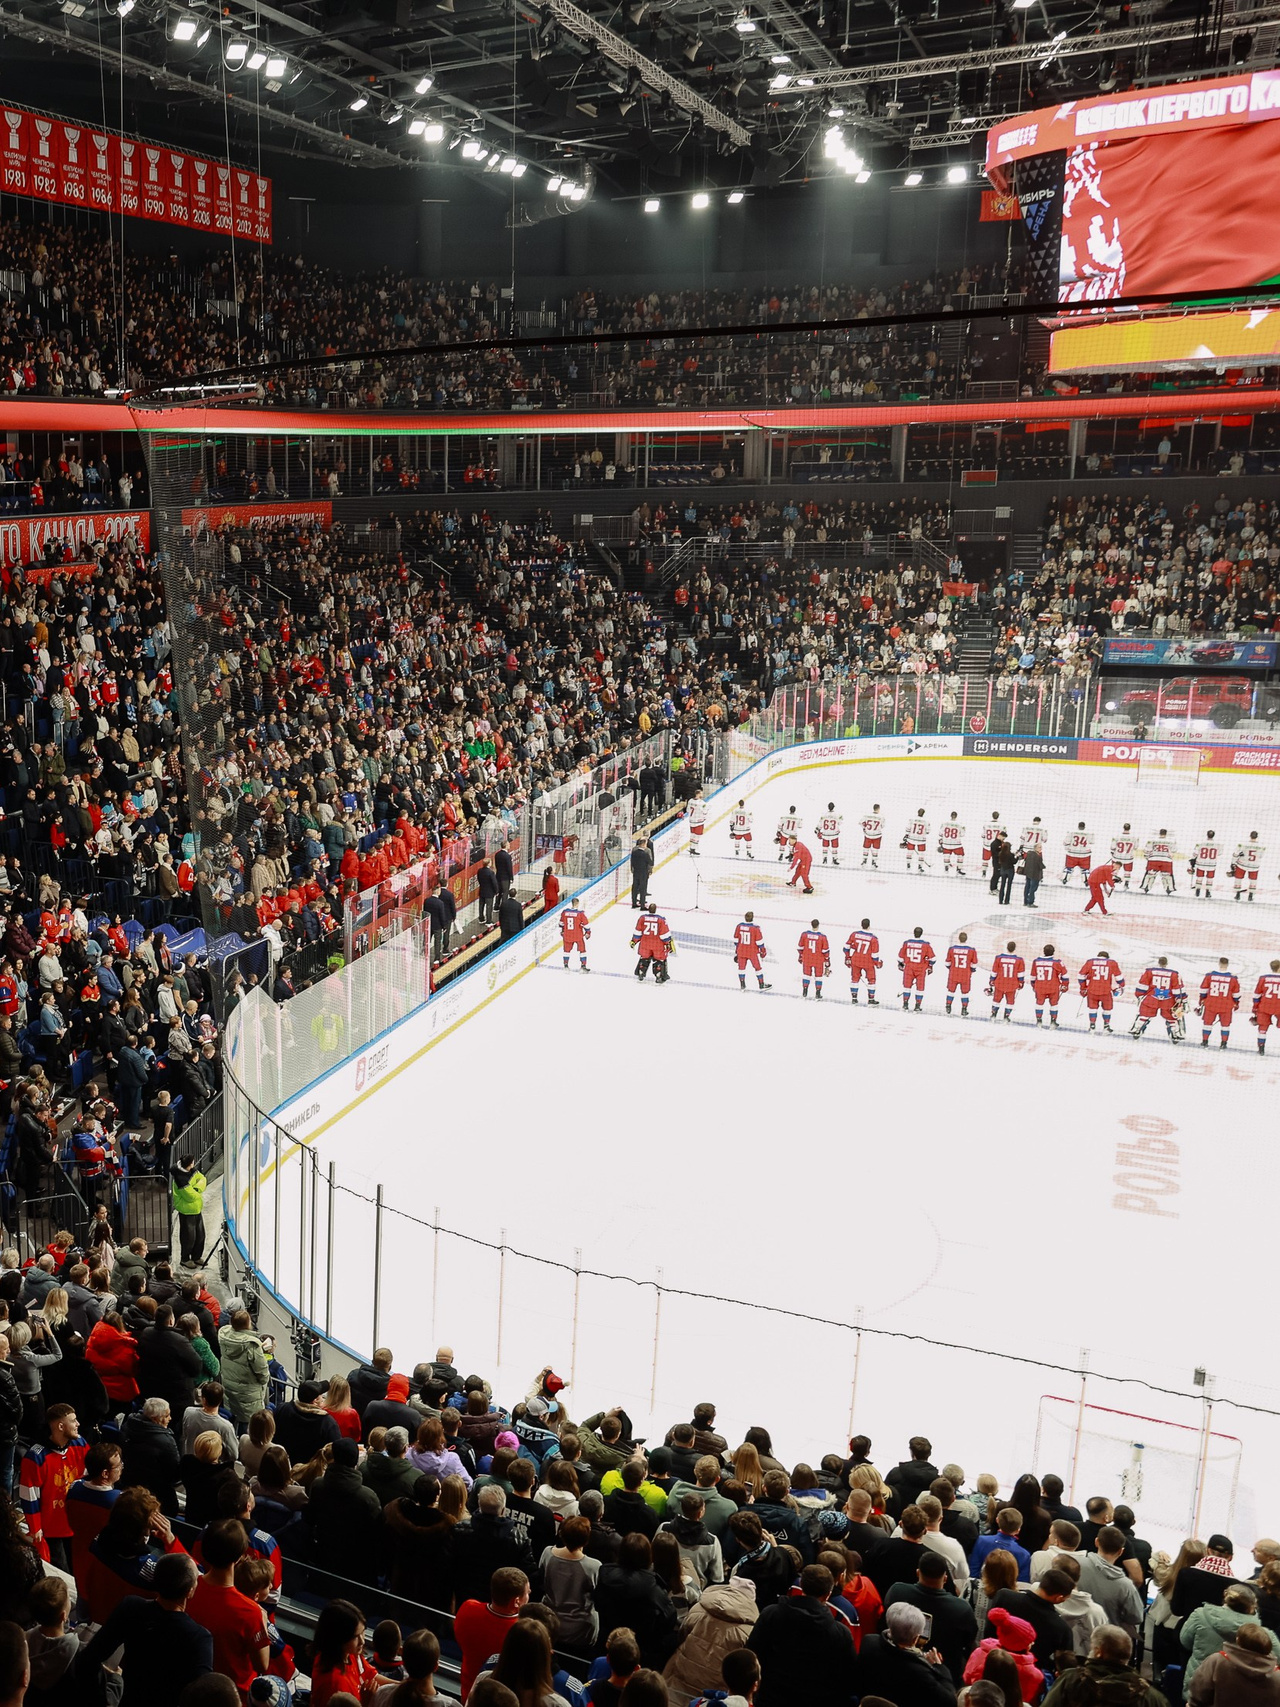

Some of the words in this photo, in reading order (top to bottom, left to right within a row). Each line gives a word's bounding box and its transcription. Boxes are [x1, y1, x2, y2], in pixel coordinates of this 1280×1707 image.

[1075, 99, 1148, 136] КУБОК
[1147, 85, 1250, 124] ПЕРВОГО
[4, 168, 26, 188] 1981
[33, 174, 57, 194] 1982
[63, 181, 85, 200] 1983
[91, 187, 113, 206] 1986
[144, 198, 165, 216] 1990
[169, 202, 189, 220] 1993
[192, 209, 211, 226] 2008
[215, 213, 233, 230] 2009
[1031, 200, 1052, 241] АРЕНА
[236, 218, 252, 235] 2012
[254, 224, 270, 239] 204
[1103, 728, 1135, 736] РОЛЬФ
[990, 742, 1068, 754] HENDERSON
[735, 815, 746, 826] 19
[786, 819, 796, 831] 11
[823, 819, 837, 831] 63
[865, 820, 880, 831] 57
[912, 822, 925, 835] 13
[944, 827, 958, 839] 88
[1027, 831, 1041, 843] 71
[1072, 835, 1088, 848] 34
[1116, 842, 1134, 854] 97
[1199, 848, 1218, 860] 80
[1248, 850, 1257, 862] 5
[566, 917, 575, 930] 8
[643, 921, 659, 936] 29
[739, 931, 752, 945] 10
[808, 940, 817, 953] 4
[855, 939, 871, 955] 77
[906, 948, 922, 963] 45
[953, 954, 967, 969] 13
[1002, 964, 1015, 978] 11
[1036, 966, 1054, 981] 87
[1091, 965, 1110, 981] 34
[1151, 975, 1172, 991] 99
[1209, 981, 1230, 997] 89
[369, 1043, 390, 1070] СПОРТ
[273, 1101, 321, 1141] РНИКЕЛЬ
[1111, 1113, 1181, 1219] РОЛЬФ
